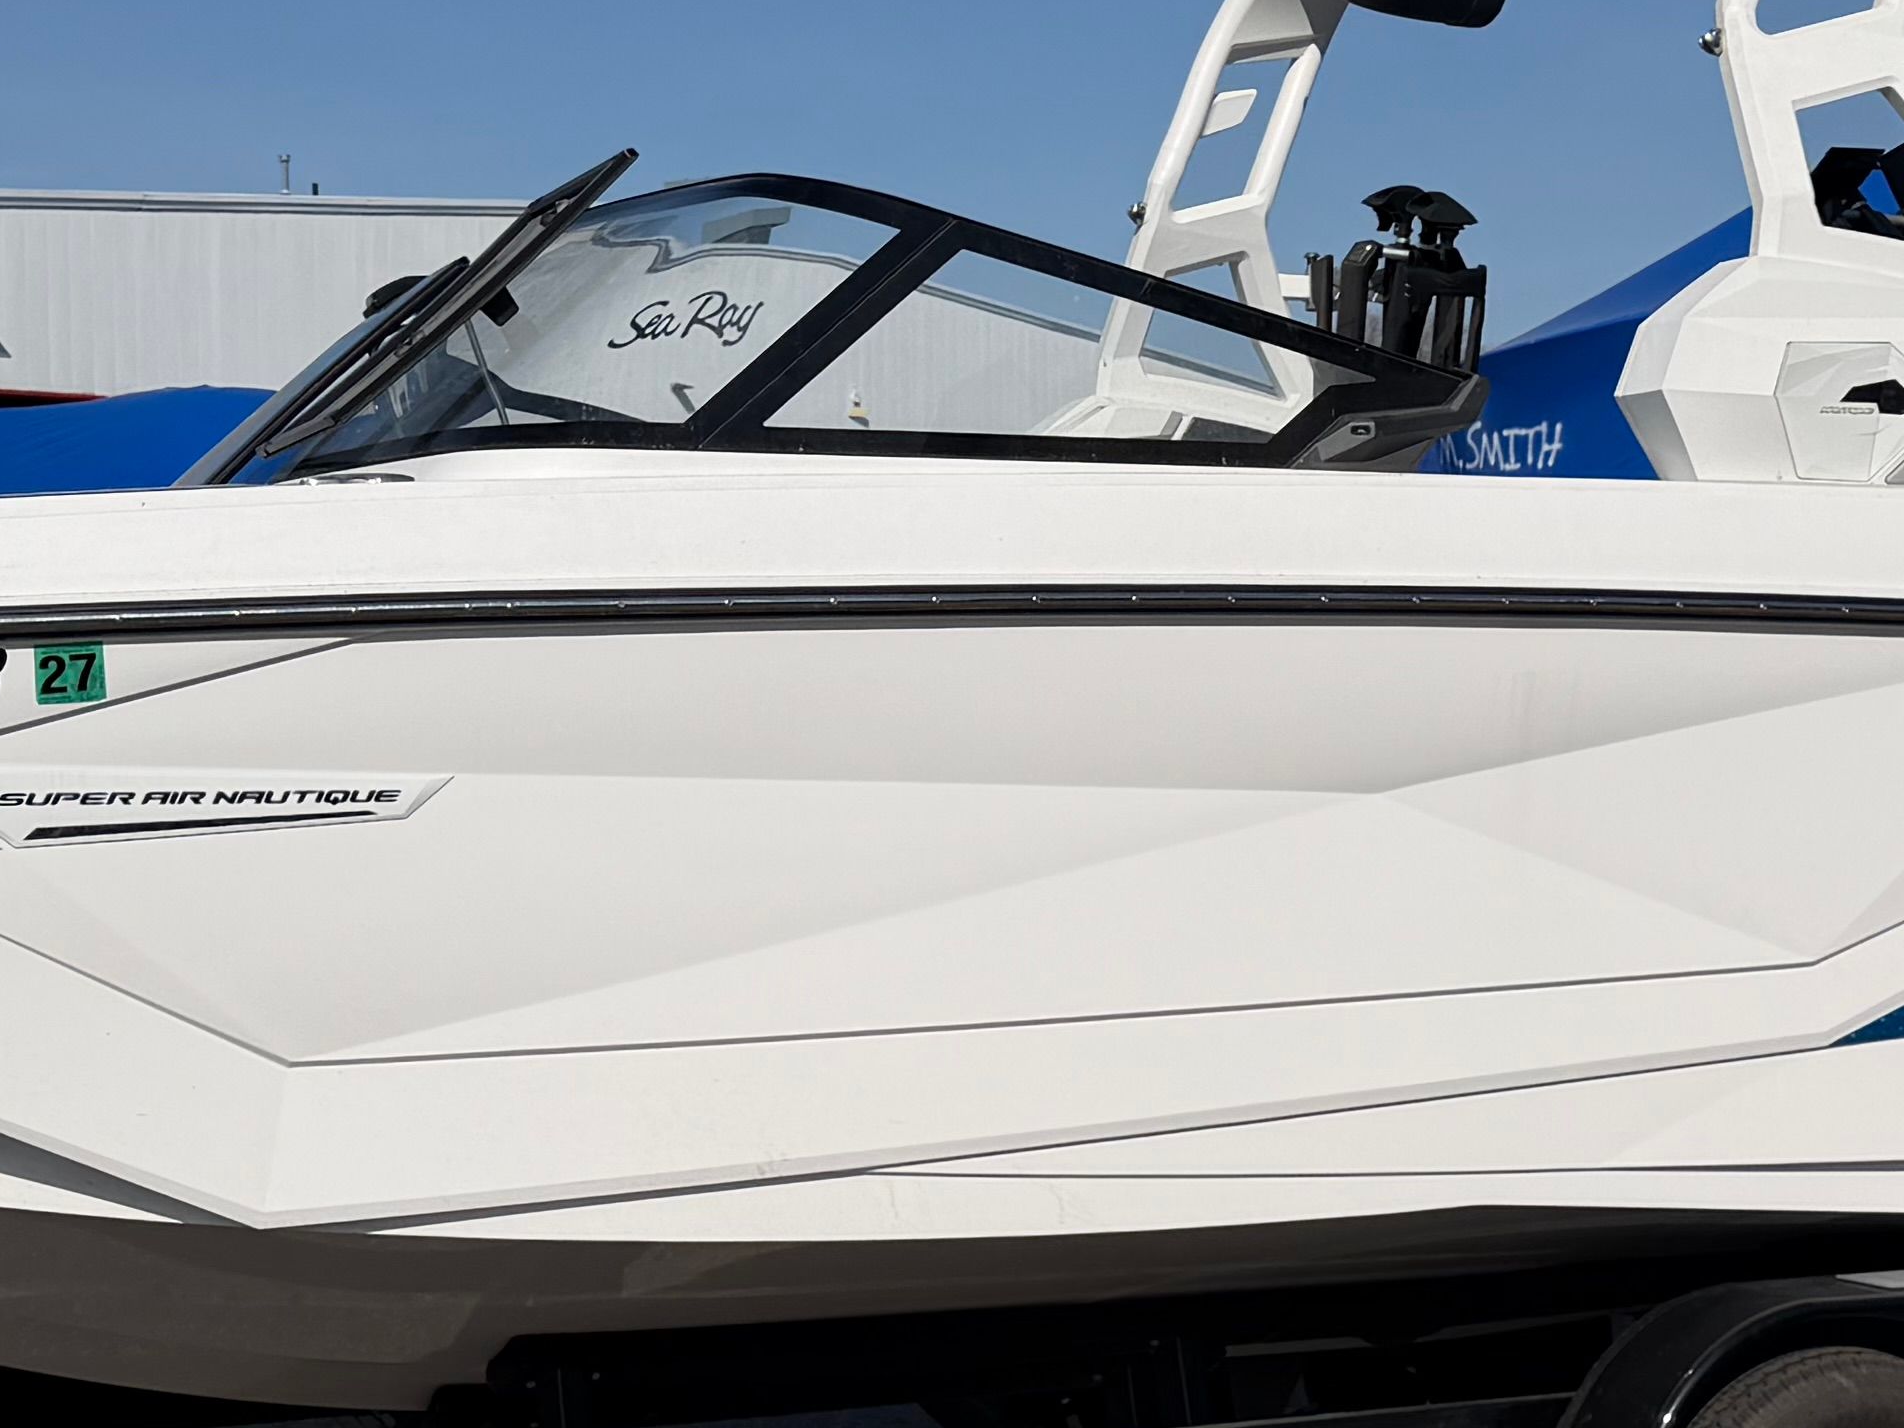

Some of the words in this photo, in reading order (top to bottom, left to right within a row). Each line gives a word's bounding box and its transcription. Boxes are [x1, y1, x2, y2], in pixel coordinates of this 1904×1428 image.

[607, 300, 681, 349] Sea
[680, 290, 765, 347] Ray
[1465, 420, 1563, 471] SMITH
[38, 652, 97, 695] 27
[141, 790, 207, 806] AIR
[212, 789, 403, 806] NAUTIQUE
